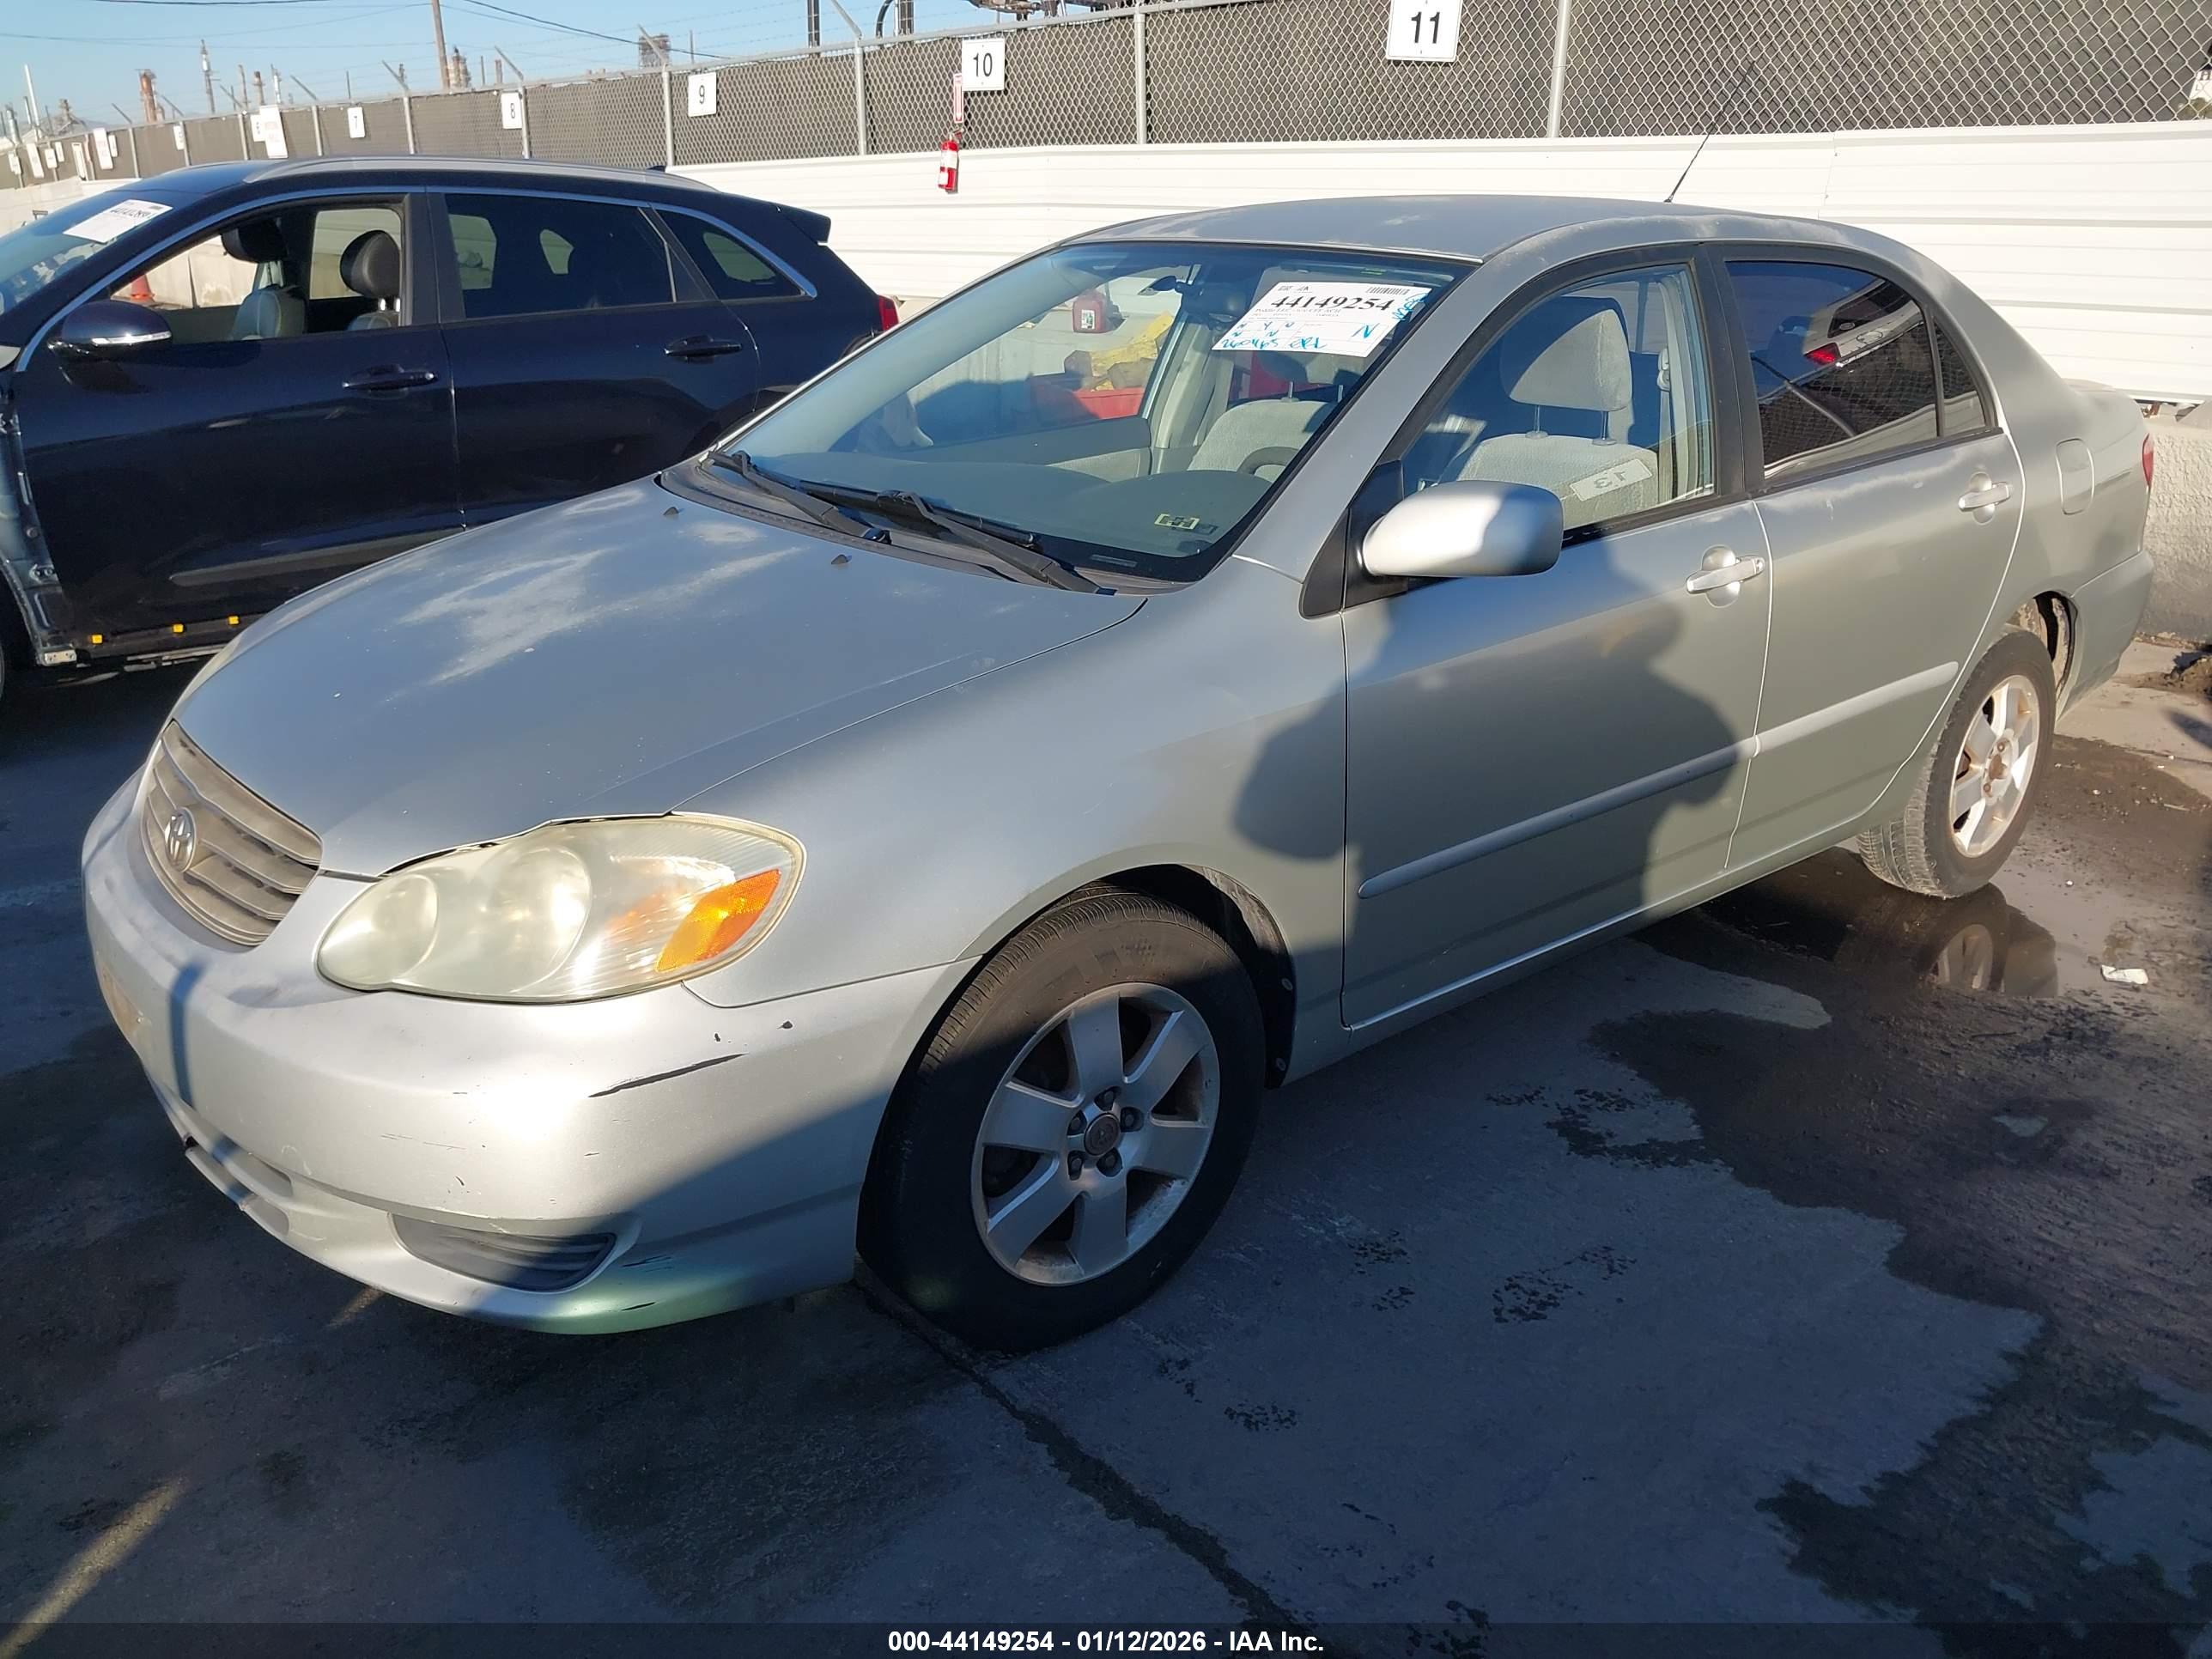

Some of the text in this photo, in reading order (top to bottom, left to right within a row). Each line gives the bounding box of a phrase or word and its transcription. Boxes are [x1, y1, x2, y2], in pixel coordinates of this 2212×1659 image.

[1411, 11, 1441, 44] 11
[973, 52, 993, 77] 10
[698, 84, 706, 105] 9
[510, 102, 516, 119] 8
[1271, 296, 1395, 310] 44149254
